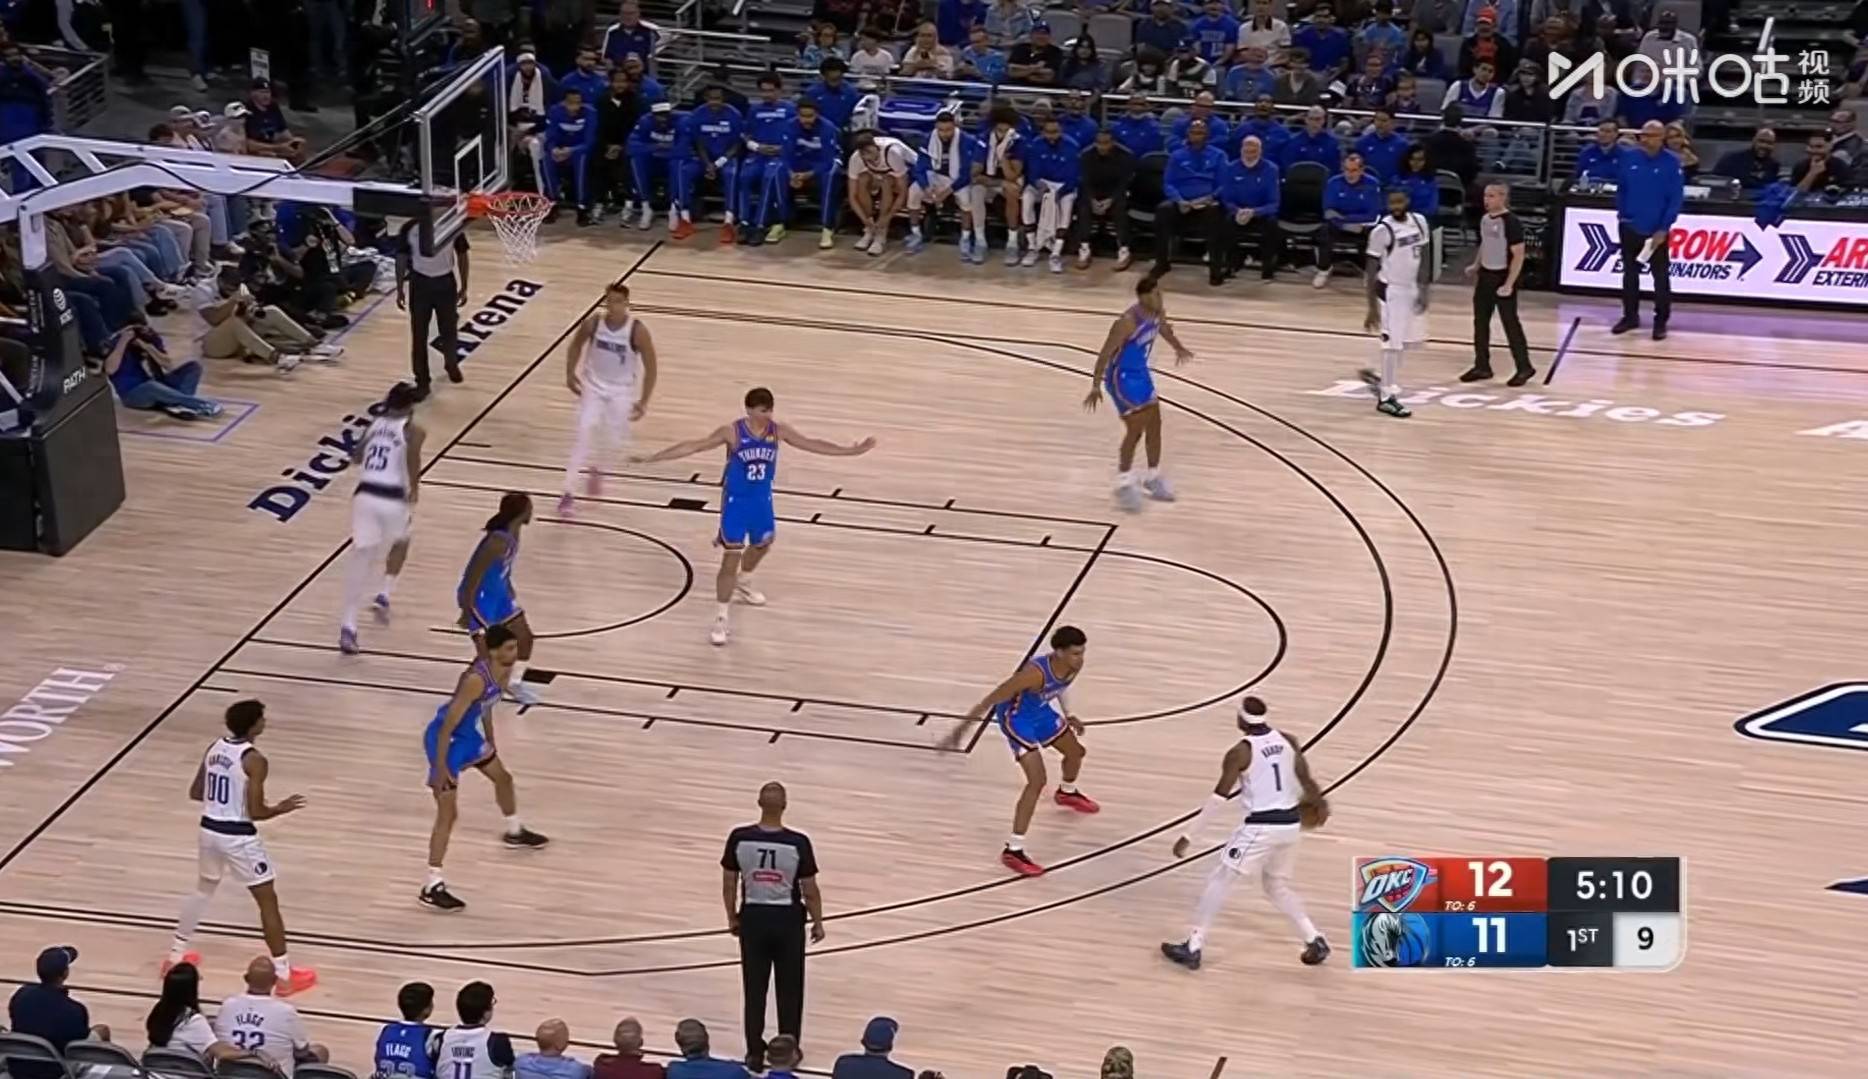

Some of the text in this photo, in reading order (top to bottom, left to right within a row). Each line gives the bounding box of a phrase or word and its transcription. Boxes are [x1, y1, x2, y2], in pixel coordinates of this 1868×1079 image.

[1668, 228, 1741, 262] ROW
[365, 446, 391, 471] 25
[747, 463, 766, 481] 23
[208, 772, 229, 805] 00
[1272, 763, 1282, 792] 1
[757, 847, 776, 870] 71
